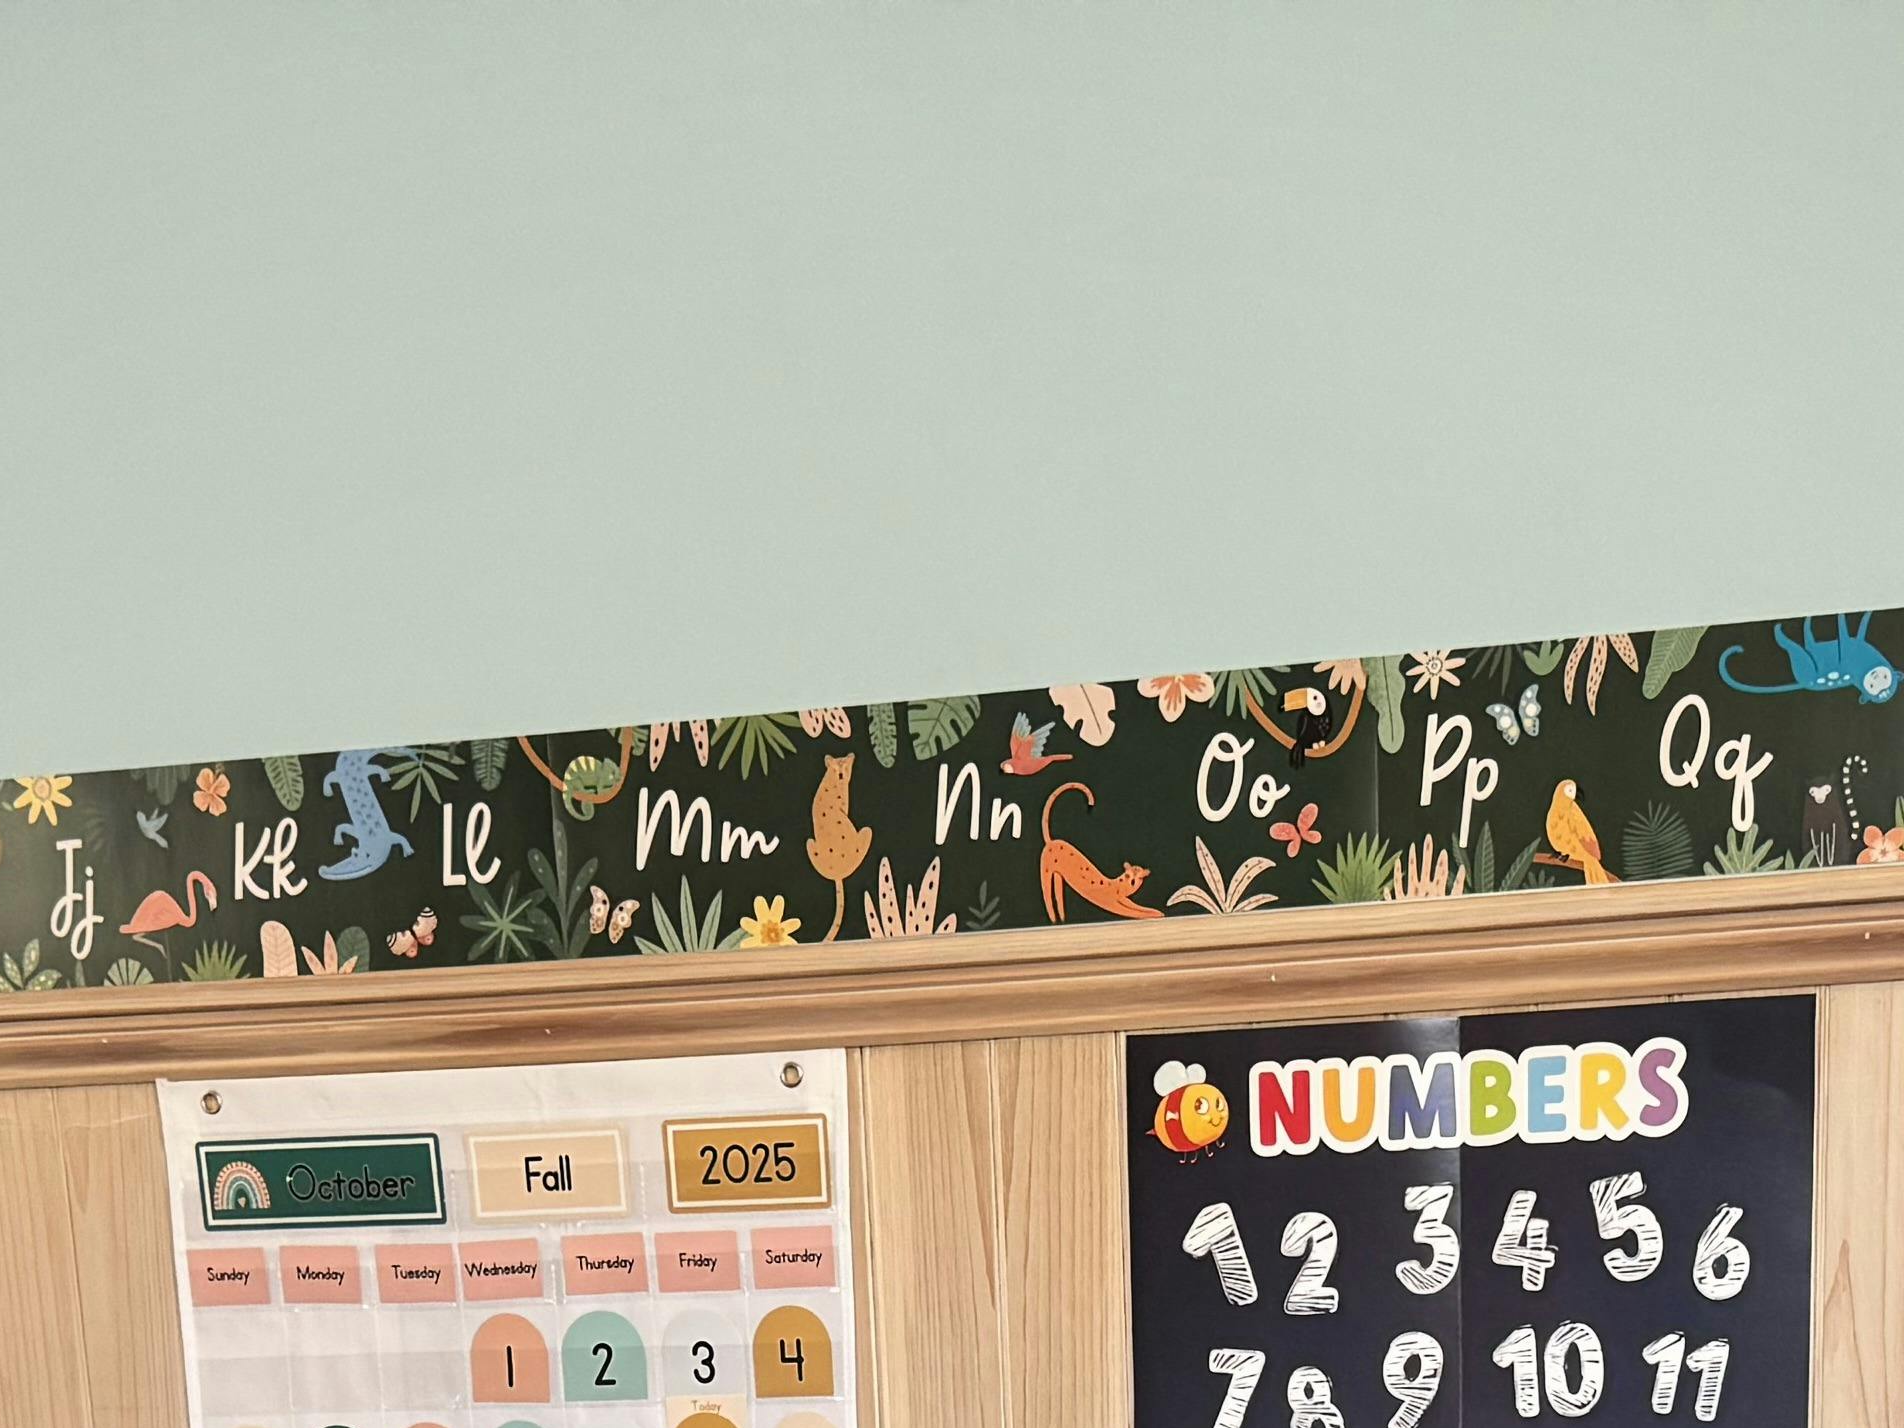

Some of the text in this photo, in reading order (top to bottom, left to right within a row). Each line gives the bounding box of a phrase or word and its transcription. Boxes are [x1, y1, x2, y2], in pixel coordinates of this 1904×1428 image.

[51, 839, 104, 960] Jj
[234, 822, 308, 900] Kk
[441, 802, 501, 887] Ll
[637, 787, 780, 869] Mm
[936, 762, 1023, 845] Nn
[1197, 731, 1290, 823] Oo
[1420, 714, 1498, 847] Pp
[1659, 694, 1773, 832] Qq
[1257, 1047, 1679, 1147] NUMBERS
[287, 1143, 796, 1200] October Fall 2025
[207, 1249, 823, 1287] Sunday Monday Tuesday Wednesday Thursday Friday Saturday
[1183, 1171, 1750, 1315] 1 2 3 4 5 6
[505, 1339, 806, 1388] 1 2 3 4
[1493, 1320, 1604, 1418] 10
[1642, 1331, 1729, 1421] 11
[691, 1400, 721, 1415] Today
